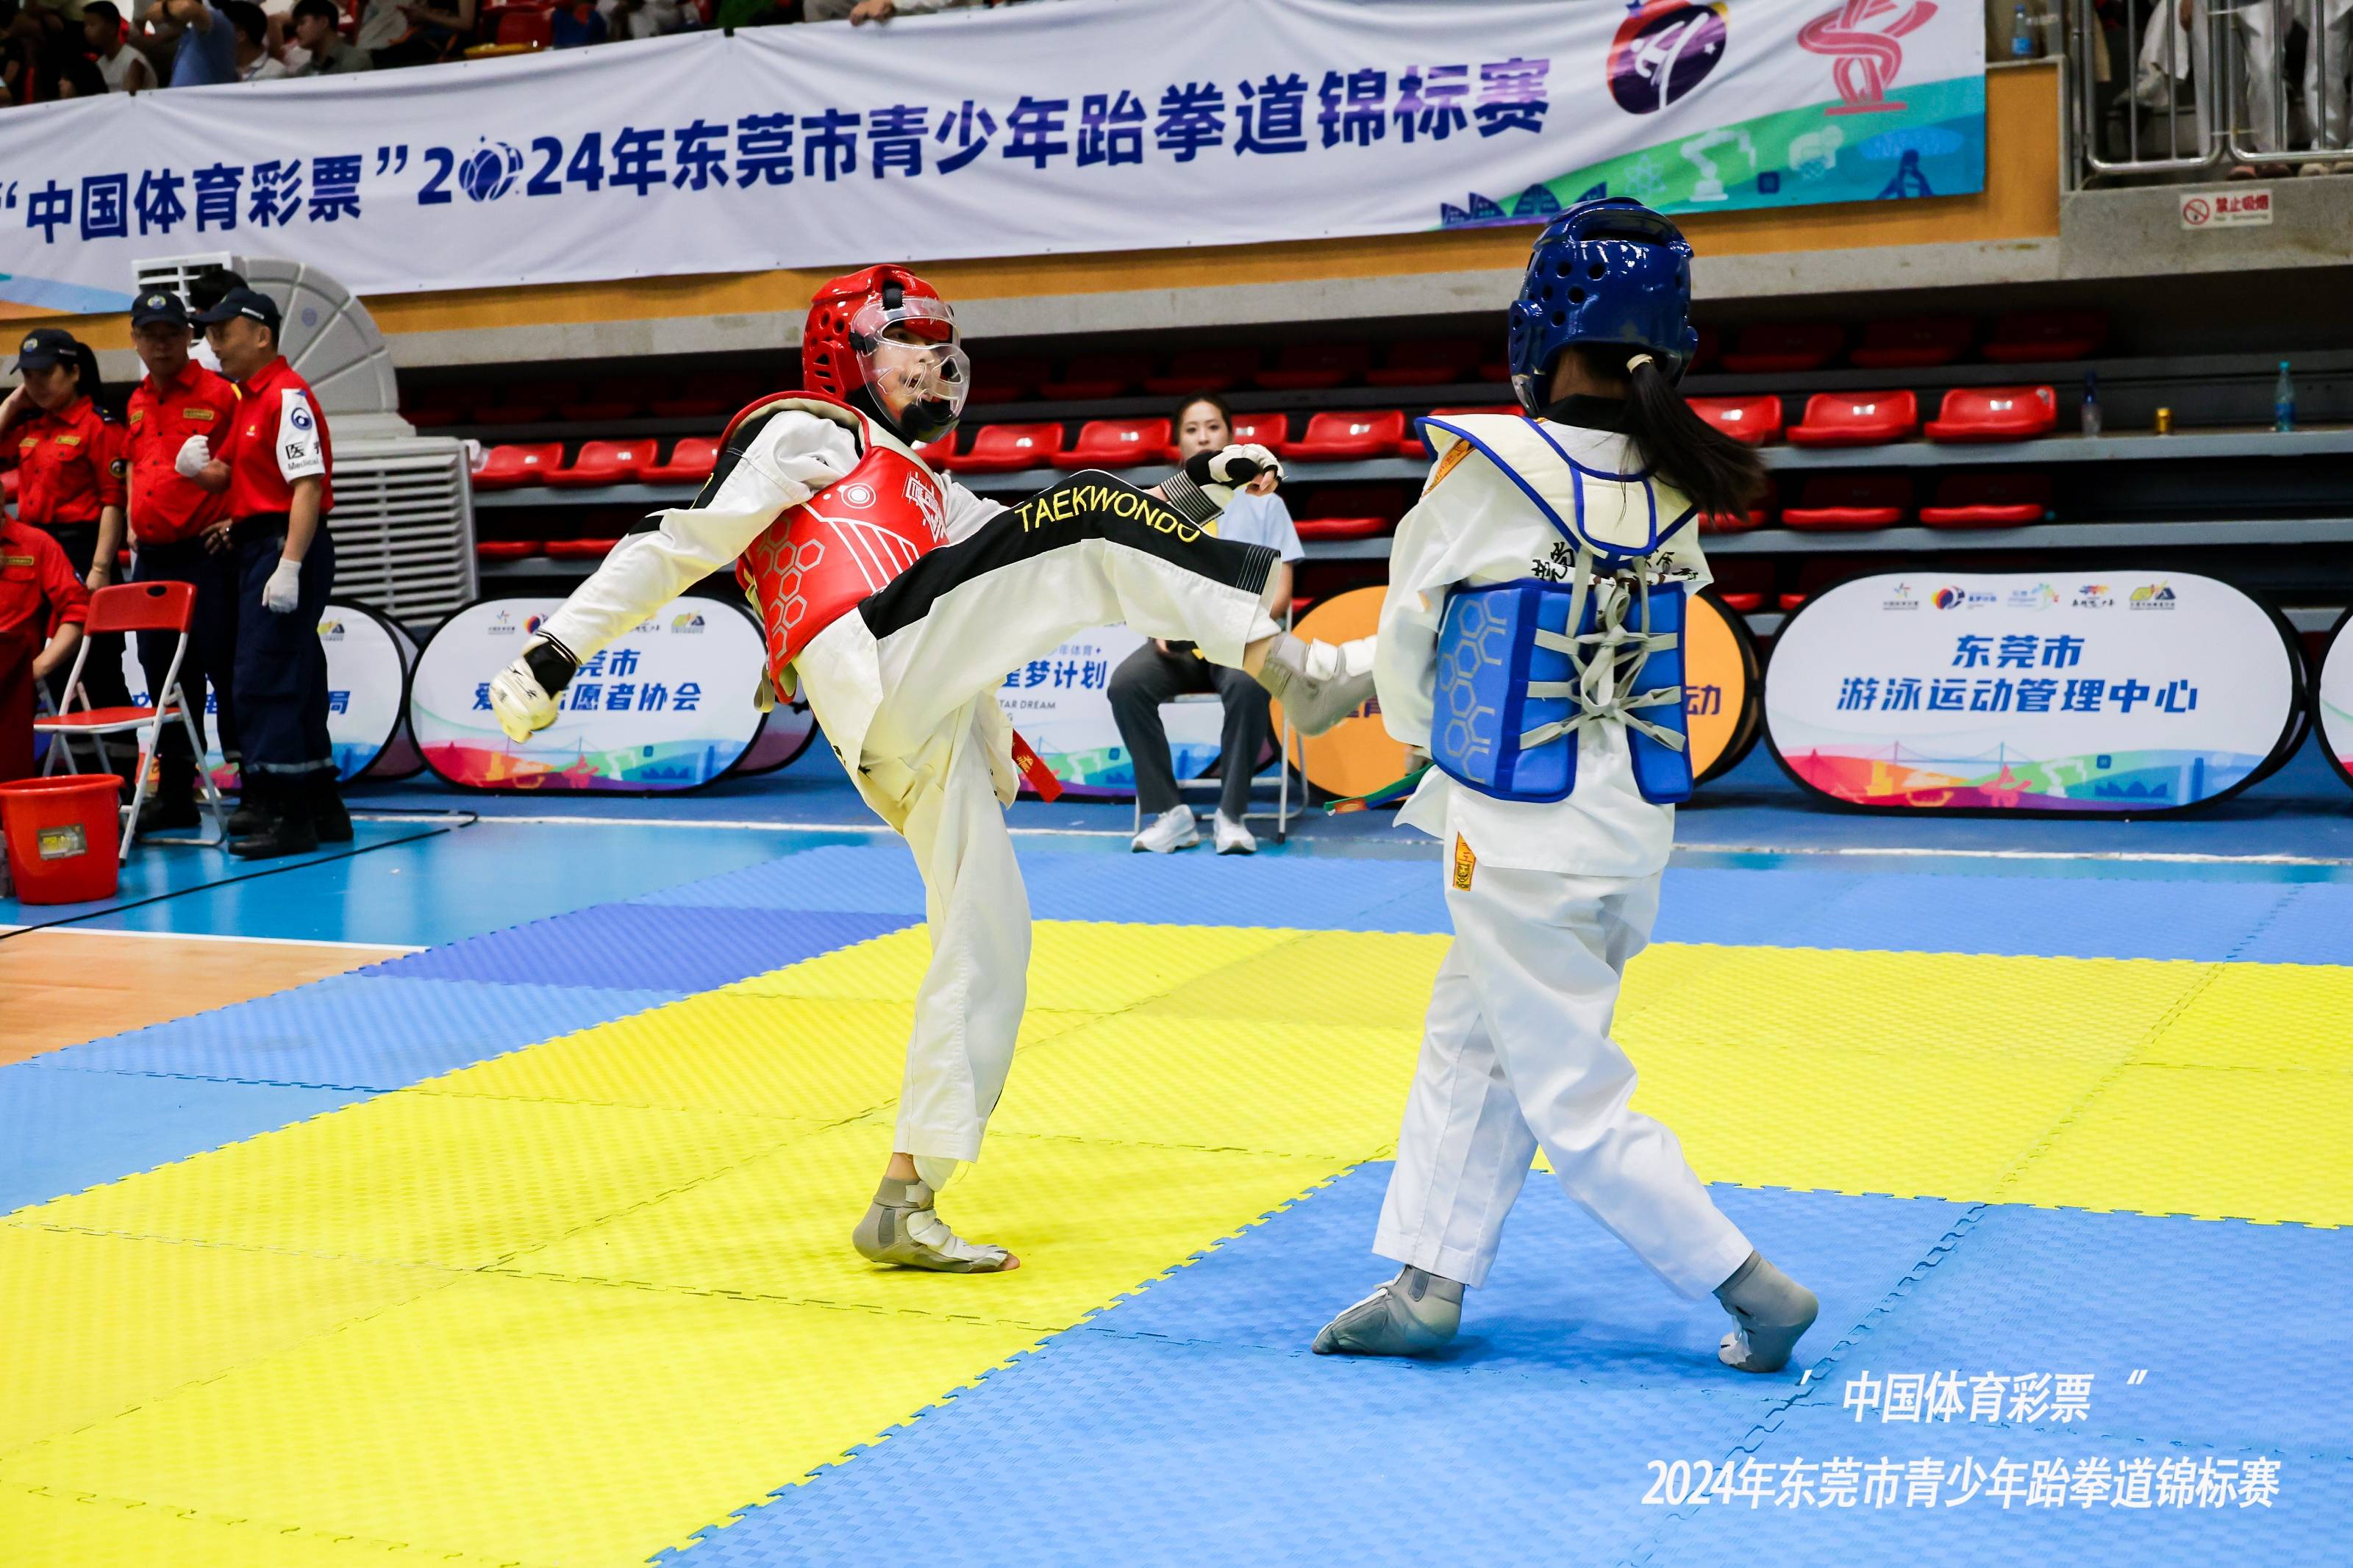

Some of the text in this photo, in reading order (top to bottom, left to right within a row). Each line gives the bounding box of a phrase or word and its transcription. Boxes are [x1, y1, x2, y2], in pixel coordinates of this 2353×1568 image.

[575, 648, 641, 677] 莞市
[1952, 634, 2085, 668] 东莞市
[472, 681, 702, 712] 爱愿者协会
[999, 700, 1056, 709] TAR DREAM
[1837, 677, 2198, 713] 游泳运动管理中心
